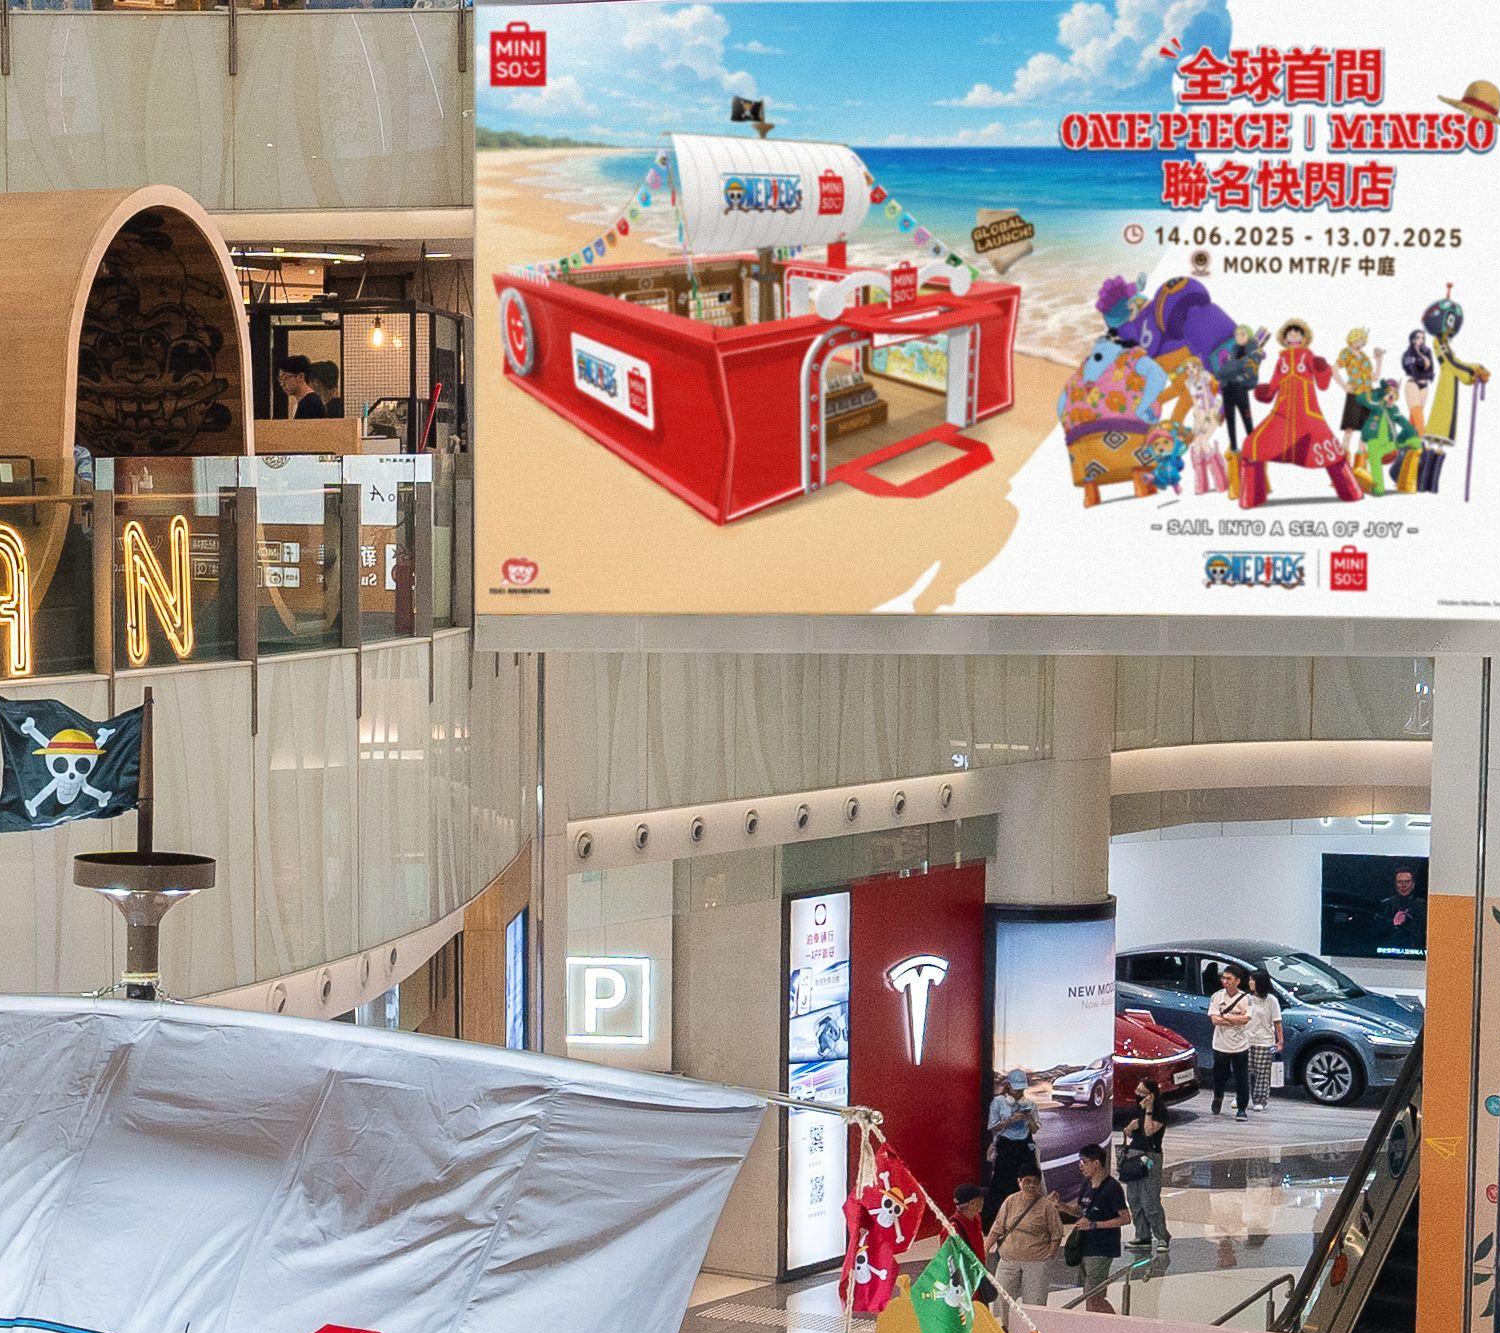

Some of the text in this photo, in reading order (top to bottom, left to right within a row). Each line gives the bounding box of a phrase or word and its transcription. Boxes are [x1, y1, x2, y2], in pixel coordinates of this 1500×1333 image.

[495, 40, 541, 57] MINI
[1178, 46, 1383, 104] 全球首間
[1061, 112, 1496, 152] ONE PIECE MINISO
[1161, 160, 1395, 211] 聯名快閃店
[972, 215, 1024, 241] GLOBAL
[975, 226, 1034, 253] LAUNCH!
[1154, 226, 1295, 247] 14.06.2025
[1324, 227, 1463, 248] 13.07.2025
[1224, 256, 1396, 277] MOKO MTR/F 中庭
[1167, 520, 1403, 538] SAIL INTO A SEA OF JOY
[1333, 559, 1364, 572] MINI
[585, 967, 627, 1033] P
[1068, 986, 1095, 998] NEW
